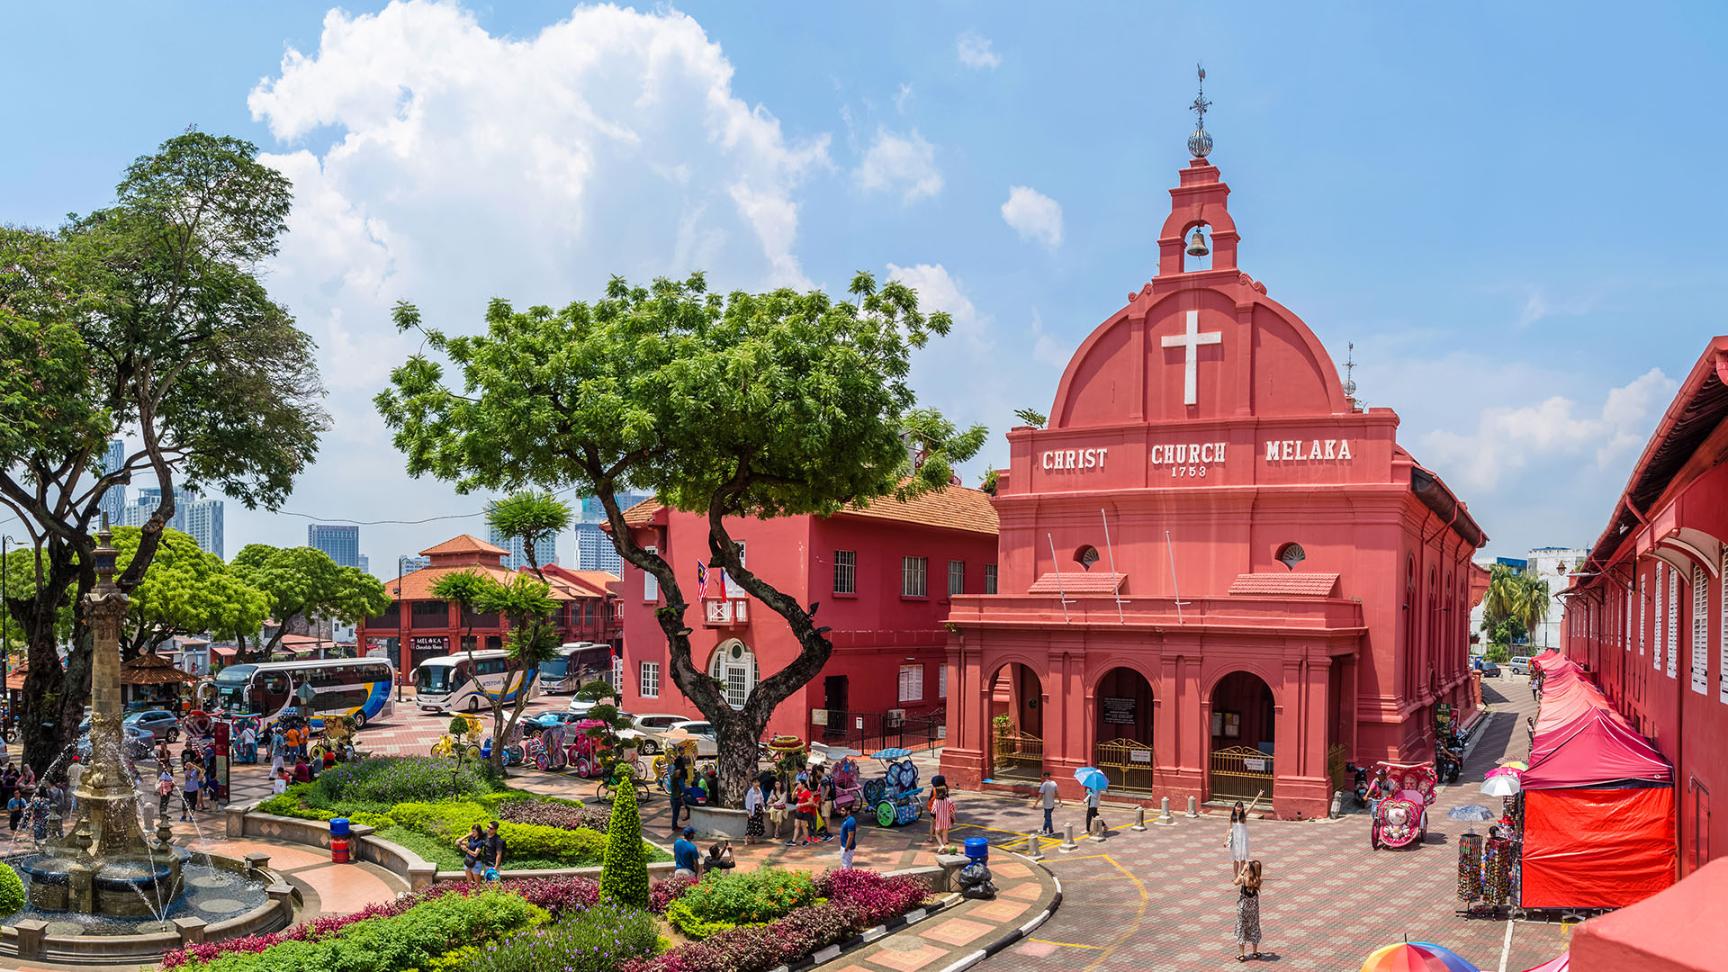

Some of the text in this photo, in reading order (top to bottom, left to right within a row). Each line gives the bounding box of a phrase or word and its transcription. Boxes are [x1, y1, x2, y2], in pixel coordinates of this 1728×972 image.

[1043, 439, 1352, 469] CHRIST CHURCH MELAKA
[1171, 466, 1206, 477] 1753
